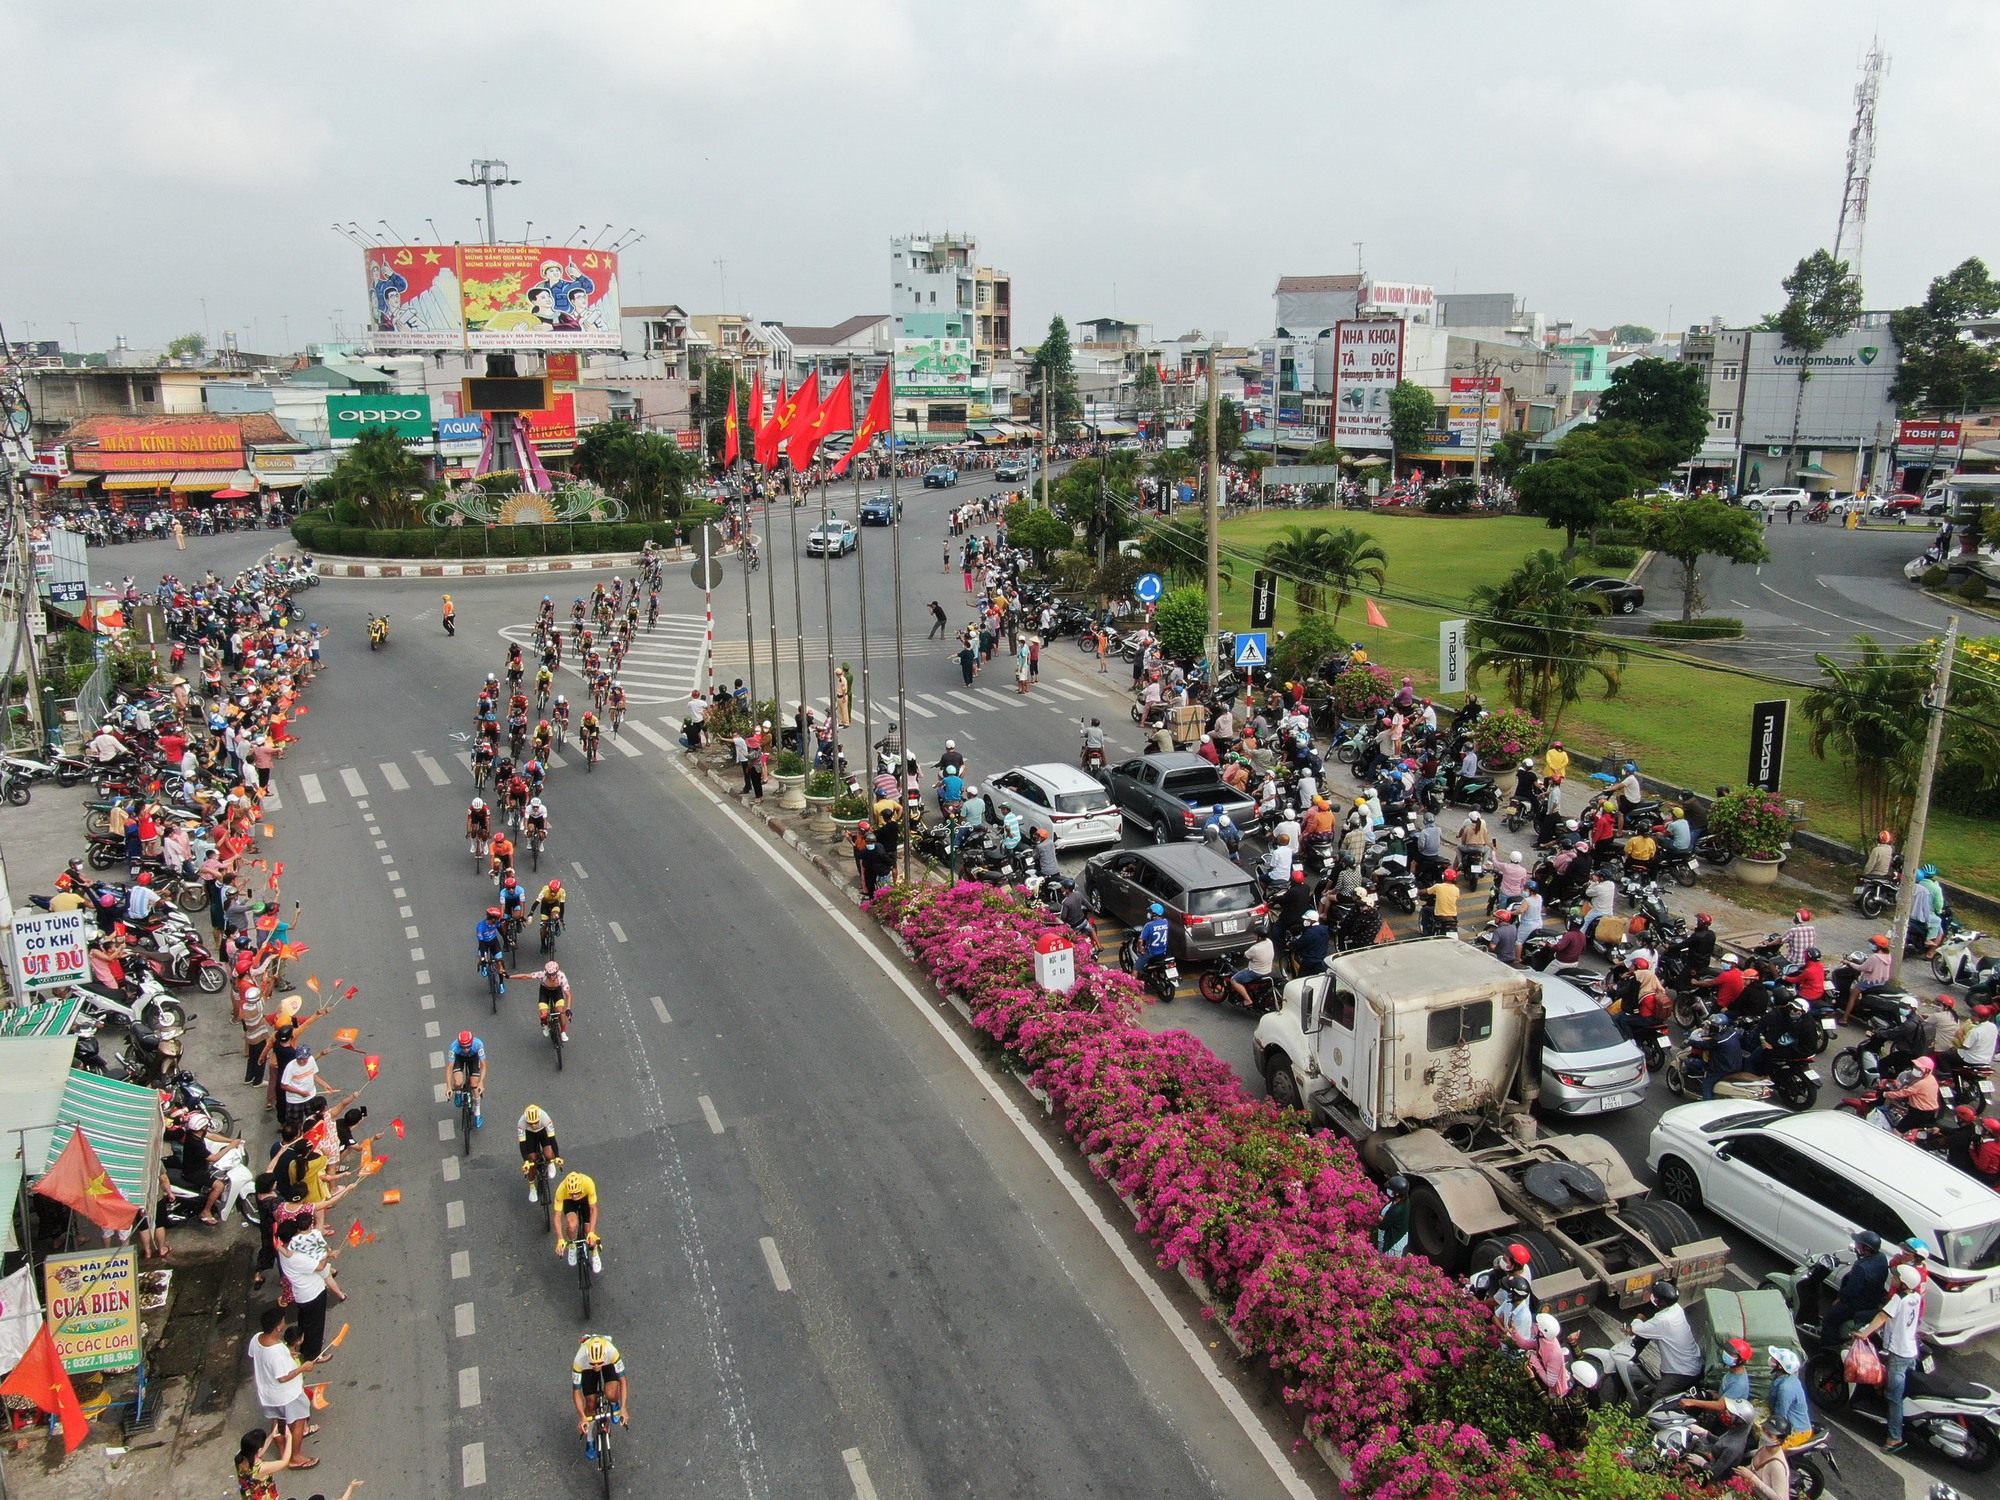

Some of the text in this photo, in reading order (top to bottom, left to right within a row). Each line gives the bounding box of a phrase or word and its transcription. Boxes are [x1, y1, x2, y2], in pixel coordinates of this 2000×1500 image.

[1342, 329, 1396, 344] NHA KHOA
[1371, 349, 1396, 366] ĐỨC
[1773, 355, 1857, 366] Vietcombank
[338, 409, 422, 424] oppo
[443, 423, 479, 434] AQUA
[1904, 430, 1955, 438] TOSHBA
[104, 428, 237, 451] MẮT KÍNH SÀI GÒN
[60, 592, 78, 600] 45
[1449, 631, 1457, 682] mazda
[1760, 715, 1774, 781] mazda
[15, 916, 79, 936] PHỤ TÙNG
[26, 930, 74, 950] CƠ KHÍ
[1151, 930, 1168, 946] 24
[22, 951, 49, 975] ÚT
[101, 1270, 128, 1281] MAU
[53, 1280, 131, 1320] CUA BIỂN
[86, 1321, 98, 1331] &
[76, 1335, 102, 1353] CÁC
[105, 1333, 134, 1350] LOẠI
[61, 1350, 134, 1370] T: 0327.188.945
